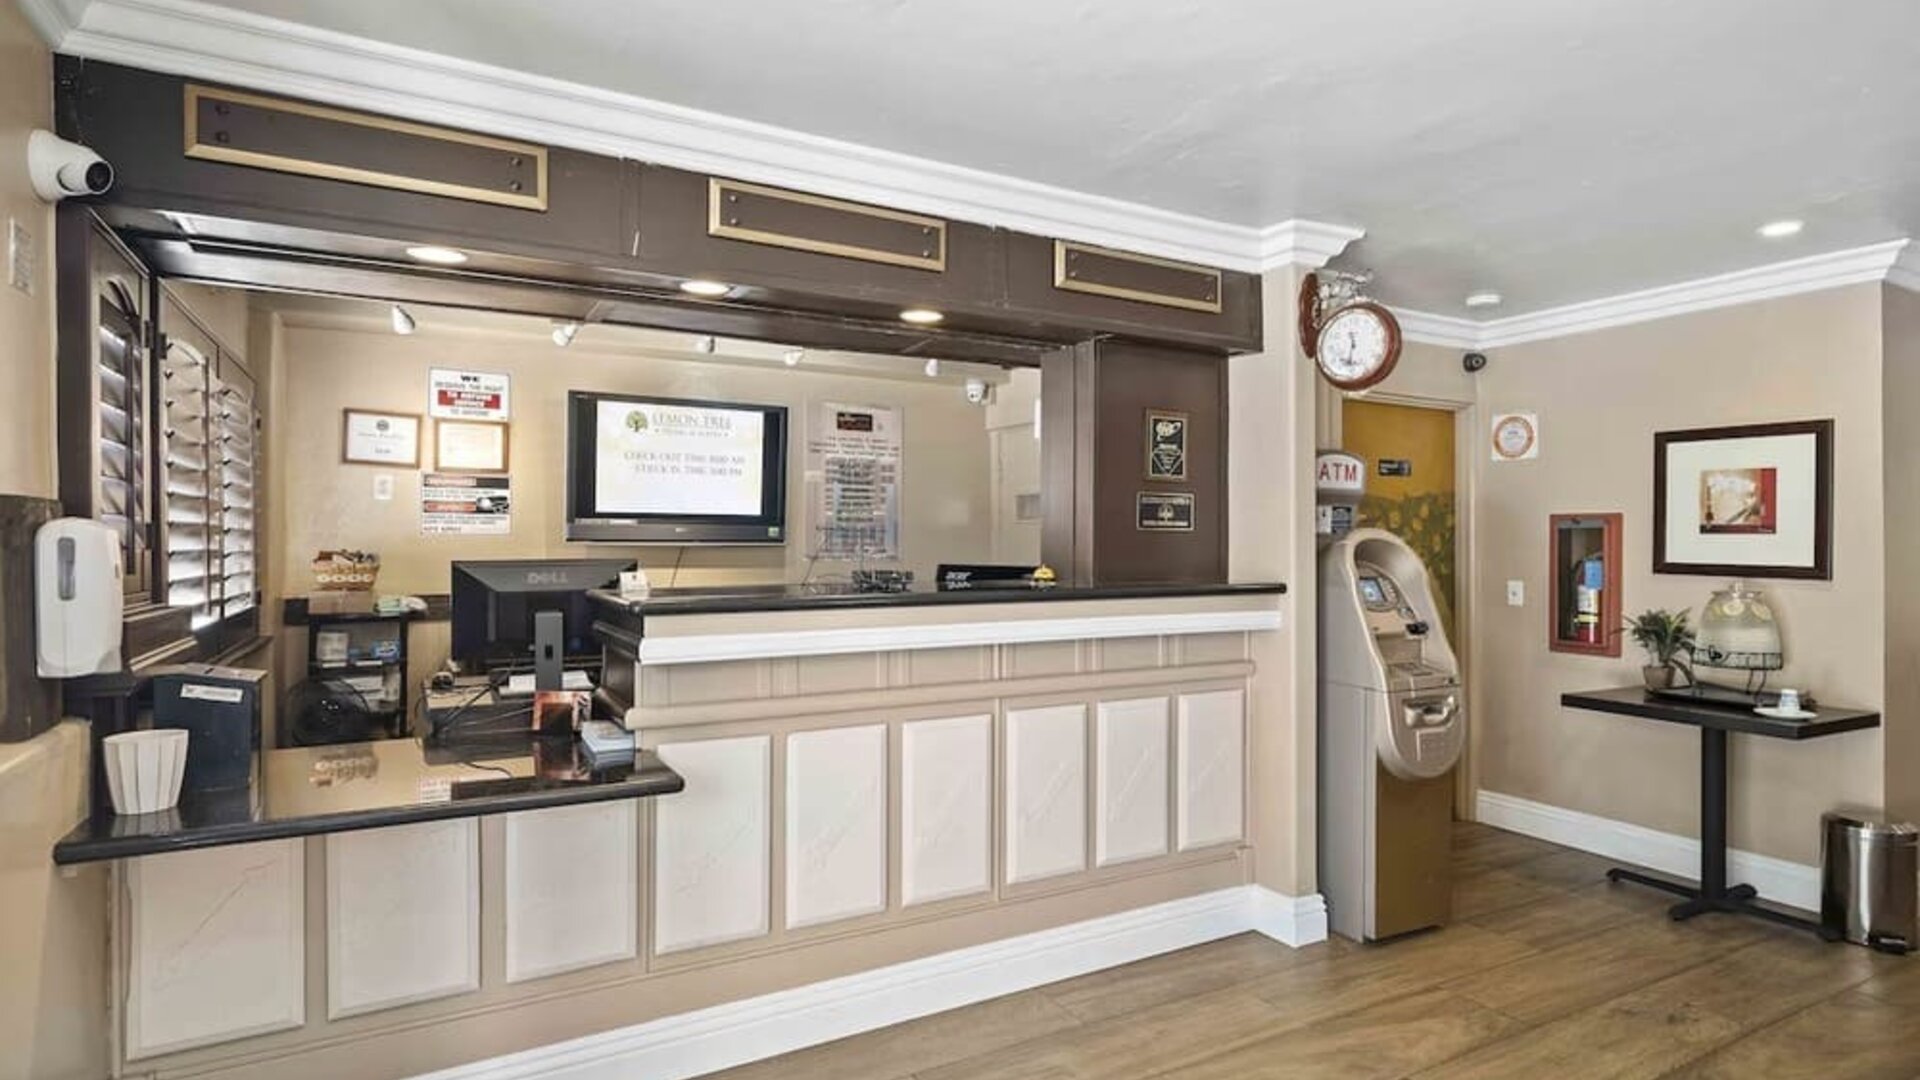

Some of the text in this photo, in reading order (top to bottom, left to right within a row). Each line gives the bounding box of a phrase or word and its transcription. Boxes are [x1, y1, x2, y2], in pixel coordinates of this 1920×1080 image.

[652, 412, 731, 430] LEMON TREE
[1319, 462, 1357, 482] ATM
[527, 571, 569, 585] DELL
[946, 571, 972, 581] acer
